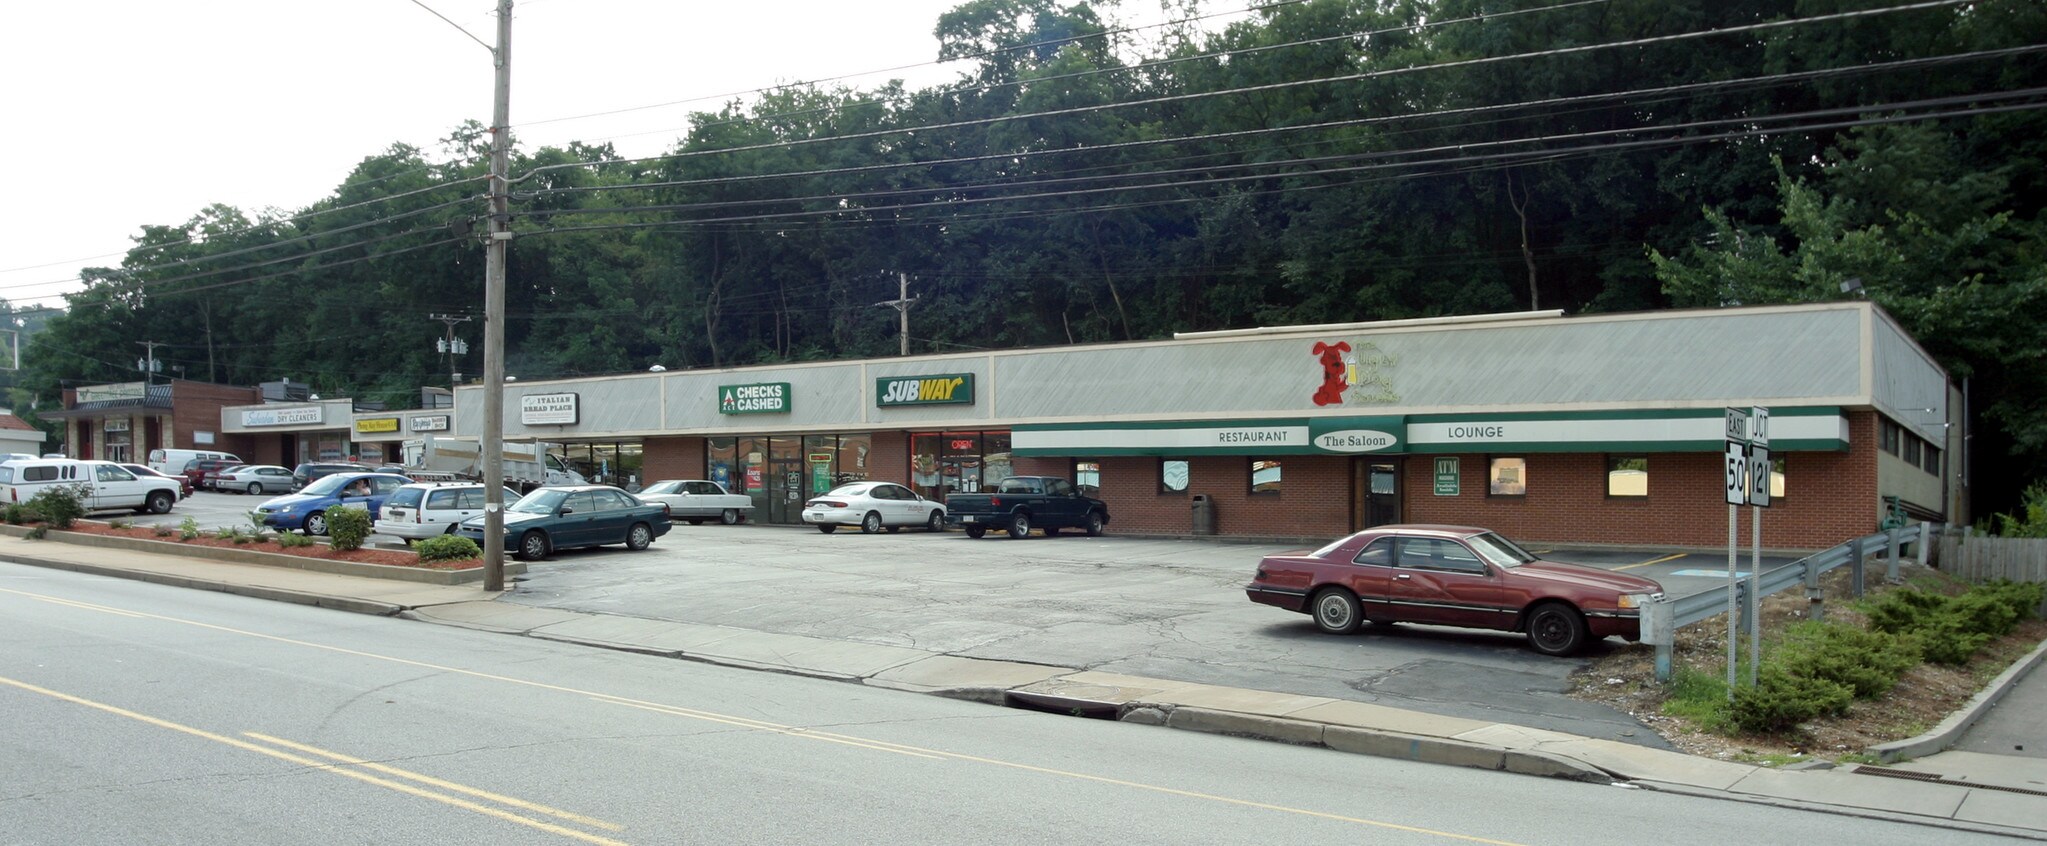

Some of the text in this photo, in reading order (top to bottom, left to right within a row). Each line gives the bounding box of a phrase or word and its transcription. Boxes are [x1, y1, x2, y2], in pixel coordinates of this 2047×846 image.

[737, 385, 782, 398] CHECKS
[882, 377, 963, 403] SUBWAY
[737, 398, 783, 410] CASHED
[289, 413, 318, 422] CLEANERS
[1728, 413, 1744, 436] EAST
[1753, 412, 1768, 438] JCT
[1219, 431, 1288, 442] RESTAURANT
[1448, 426, 1504, 438] LOUNGE
[1324, 436, 1387, 446] The Saloon
[1436, 460, 1457, 474] ATM
[1728, 458, 1744, 492] 50
[1752, 461, 1768, 495] 121
